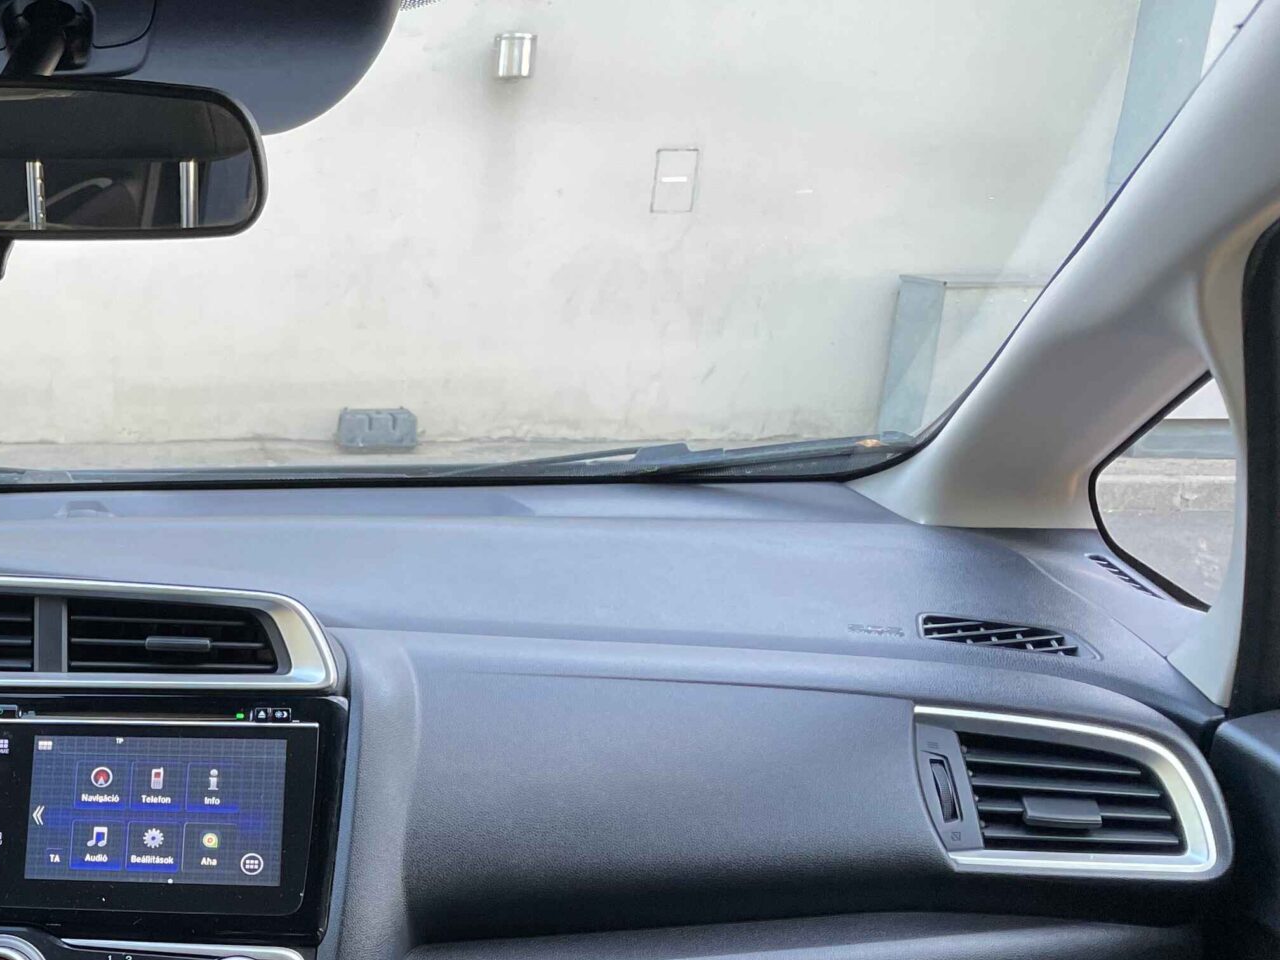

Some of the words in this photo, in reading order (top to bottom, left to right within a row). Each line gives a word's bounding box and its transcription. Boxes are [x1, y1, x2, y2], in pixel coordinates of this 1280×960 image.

[81, 793, 120, 803] Navigáció
[141, 795, 172, 804] Telefon
[204, 796, 221, 805] Info
[49, 854, 61, 863] TA
[200, 857, 218, 866] Aha
